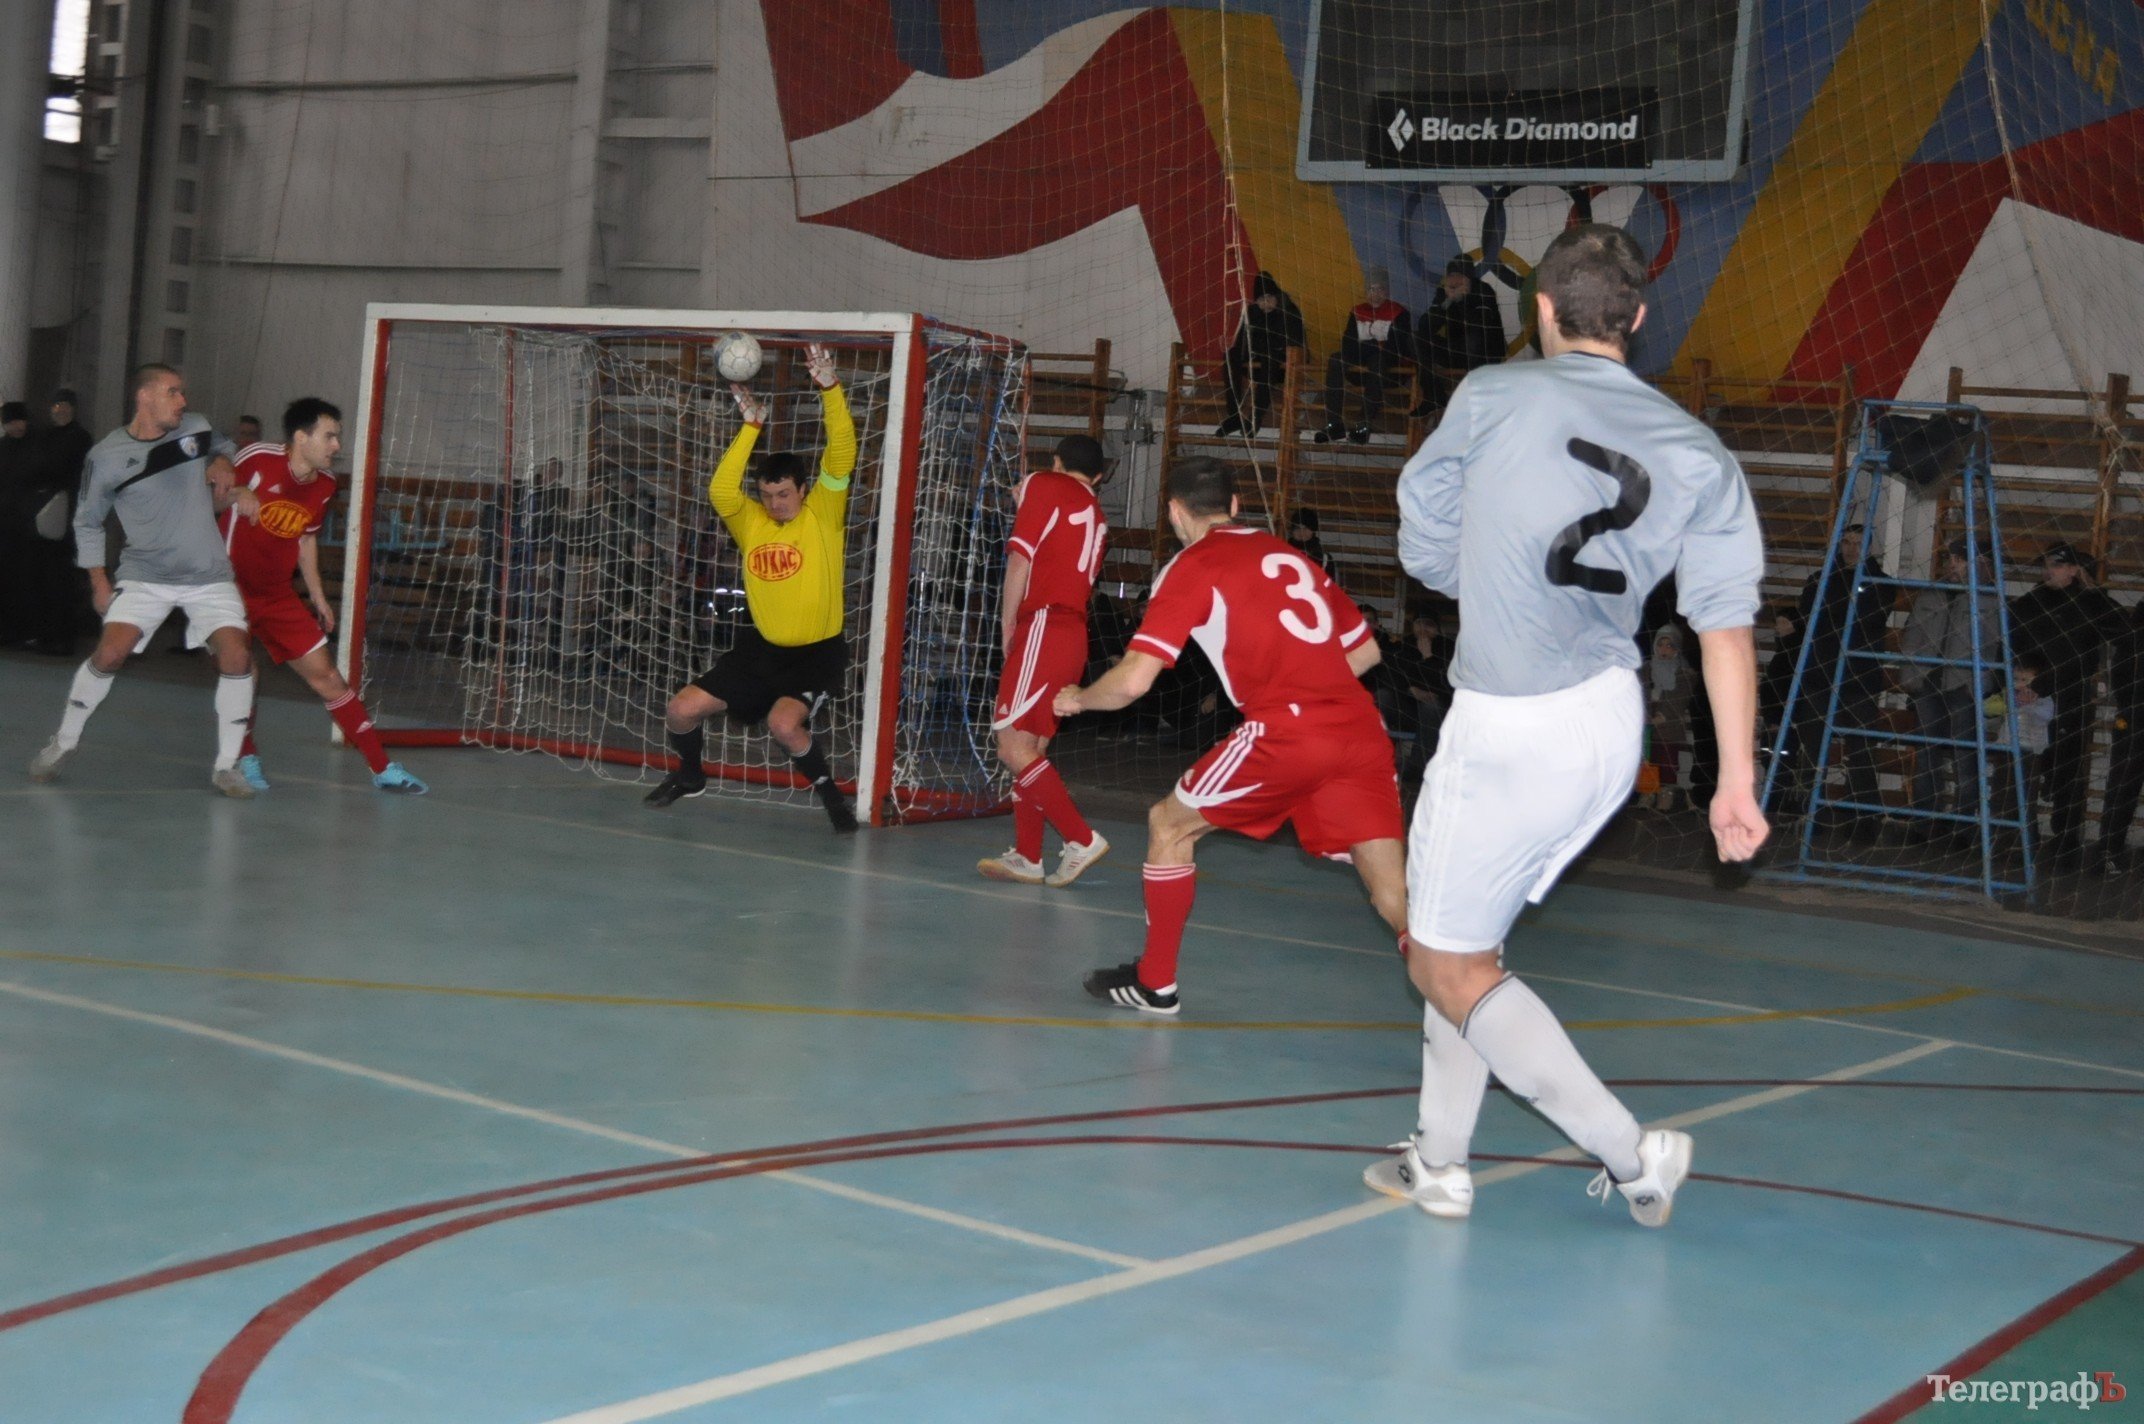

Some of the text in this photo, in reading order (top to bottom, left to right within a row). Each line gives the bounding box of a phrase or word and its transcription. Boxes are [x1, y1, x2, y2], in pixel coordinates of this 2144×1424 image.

[1421, 115, 1638, 141] Black Diamond
[1545, 437, 1652, 595] 2
[1261, 553, 1334, 644] 3
